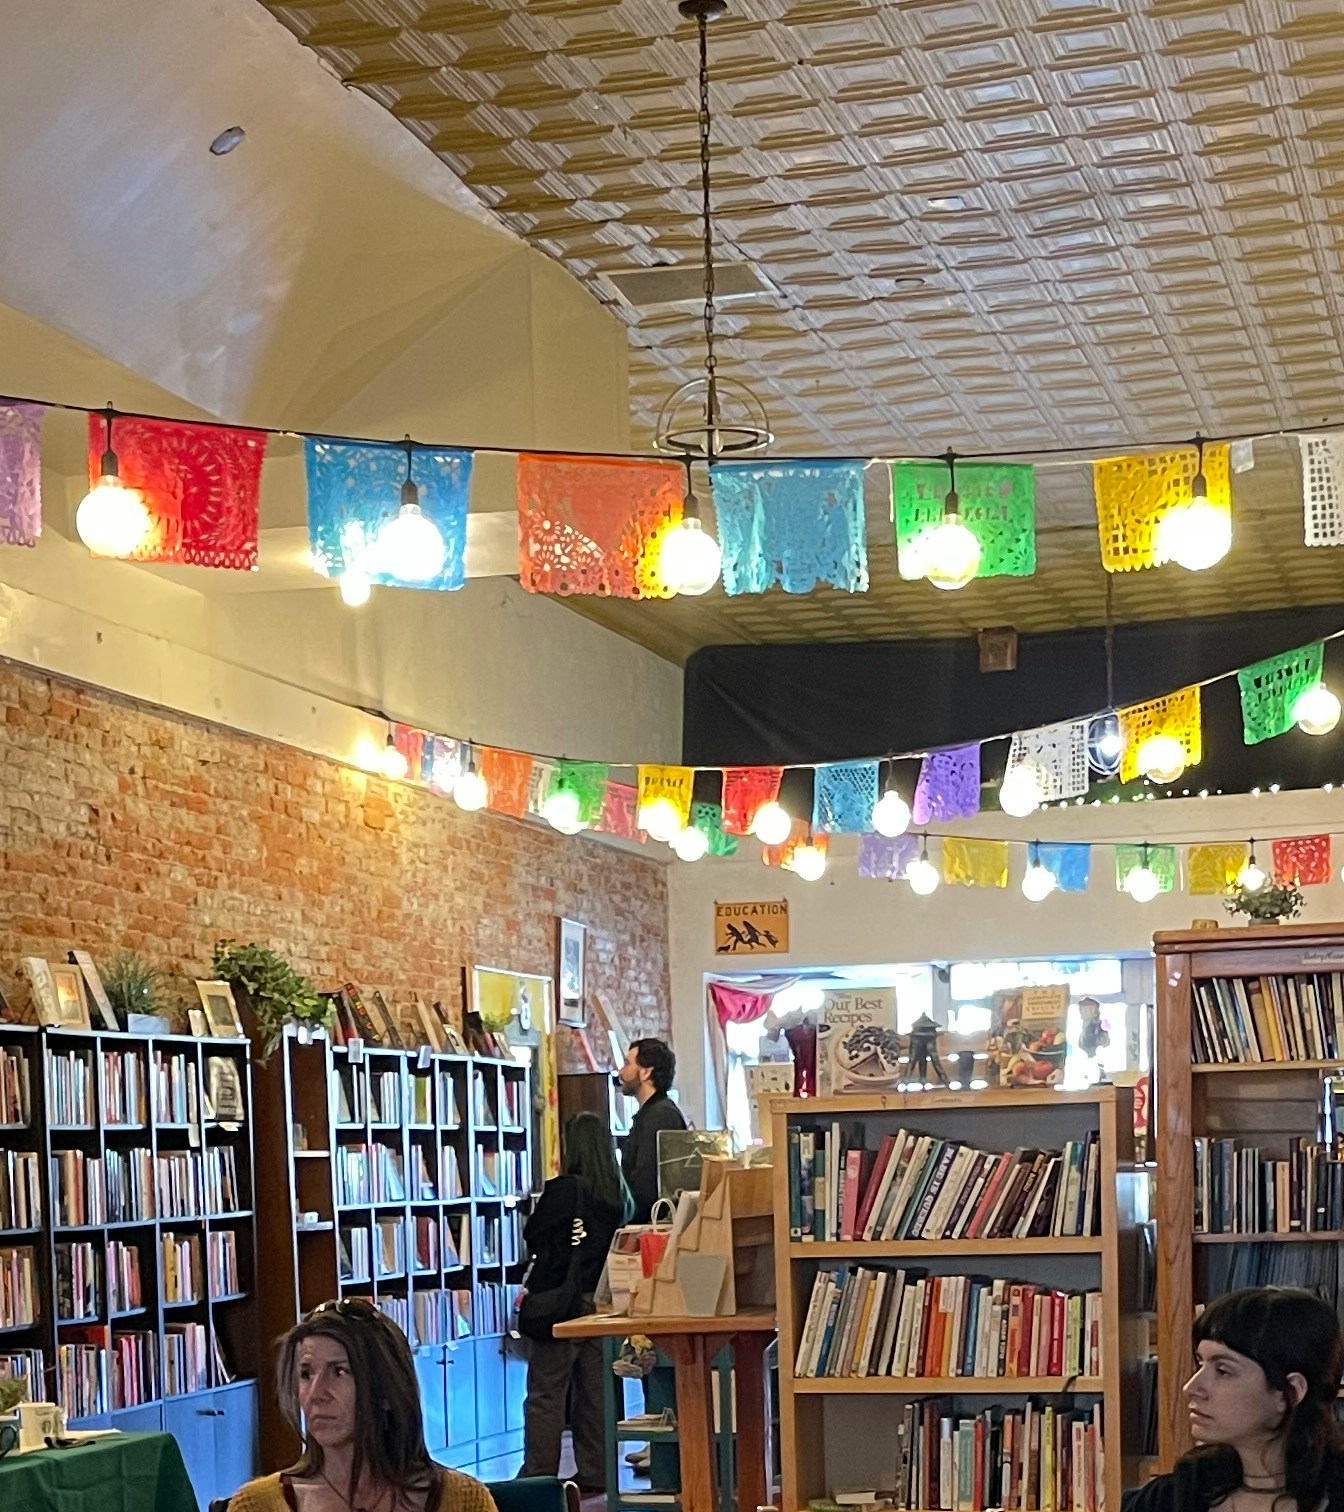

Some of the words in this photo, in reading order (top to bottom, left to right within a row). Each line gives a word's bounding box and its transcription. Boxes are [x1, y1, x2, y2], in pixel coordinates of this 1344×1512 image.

[717, 905, 787, 917] EDUCATION
[824, 999, 851, 1011] Our
[855, 997, 883, 1010] Best
[824, 1011, 873, 1027] Recipes
